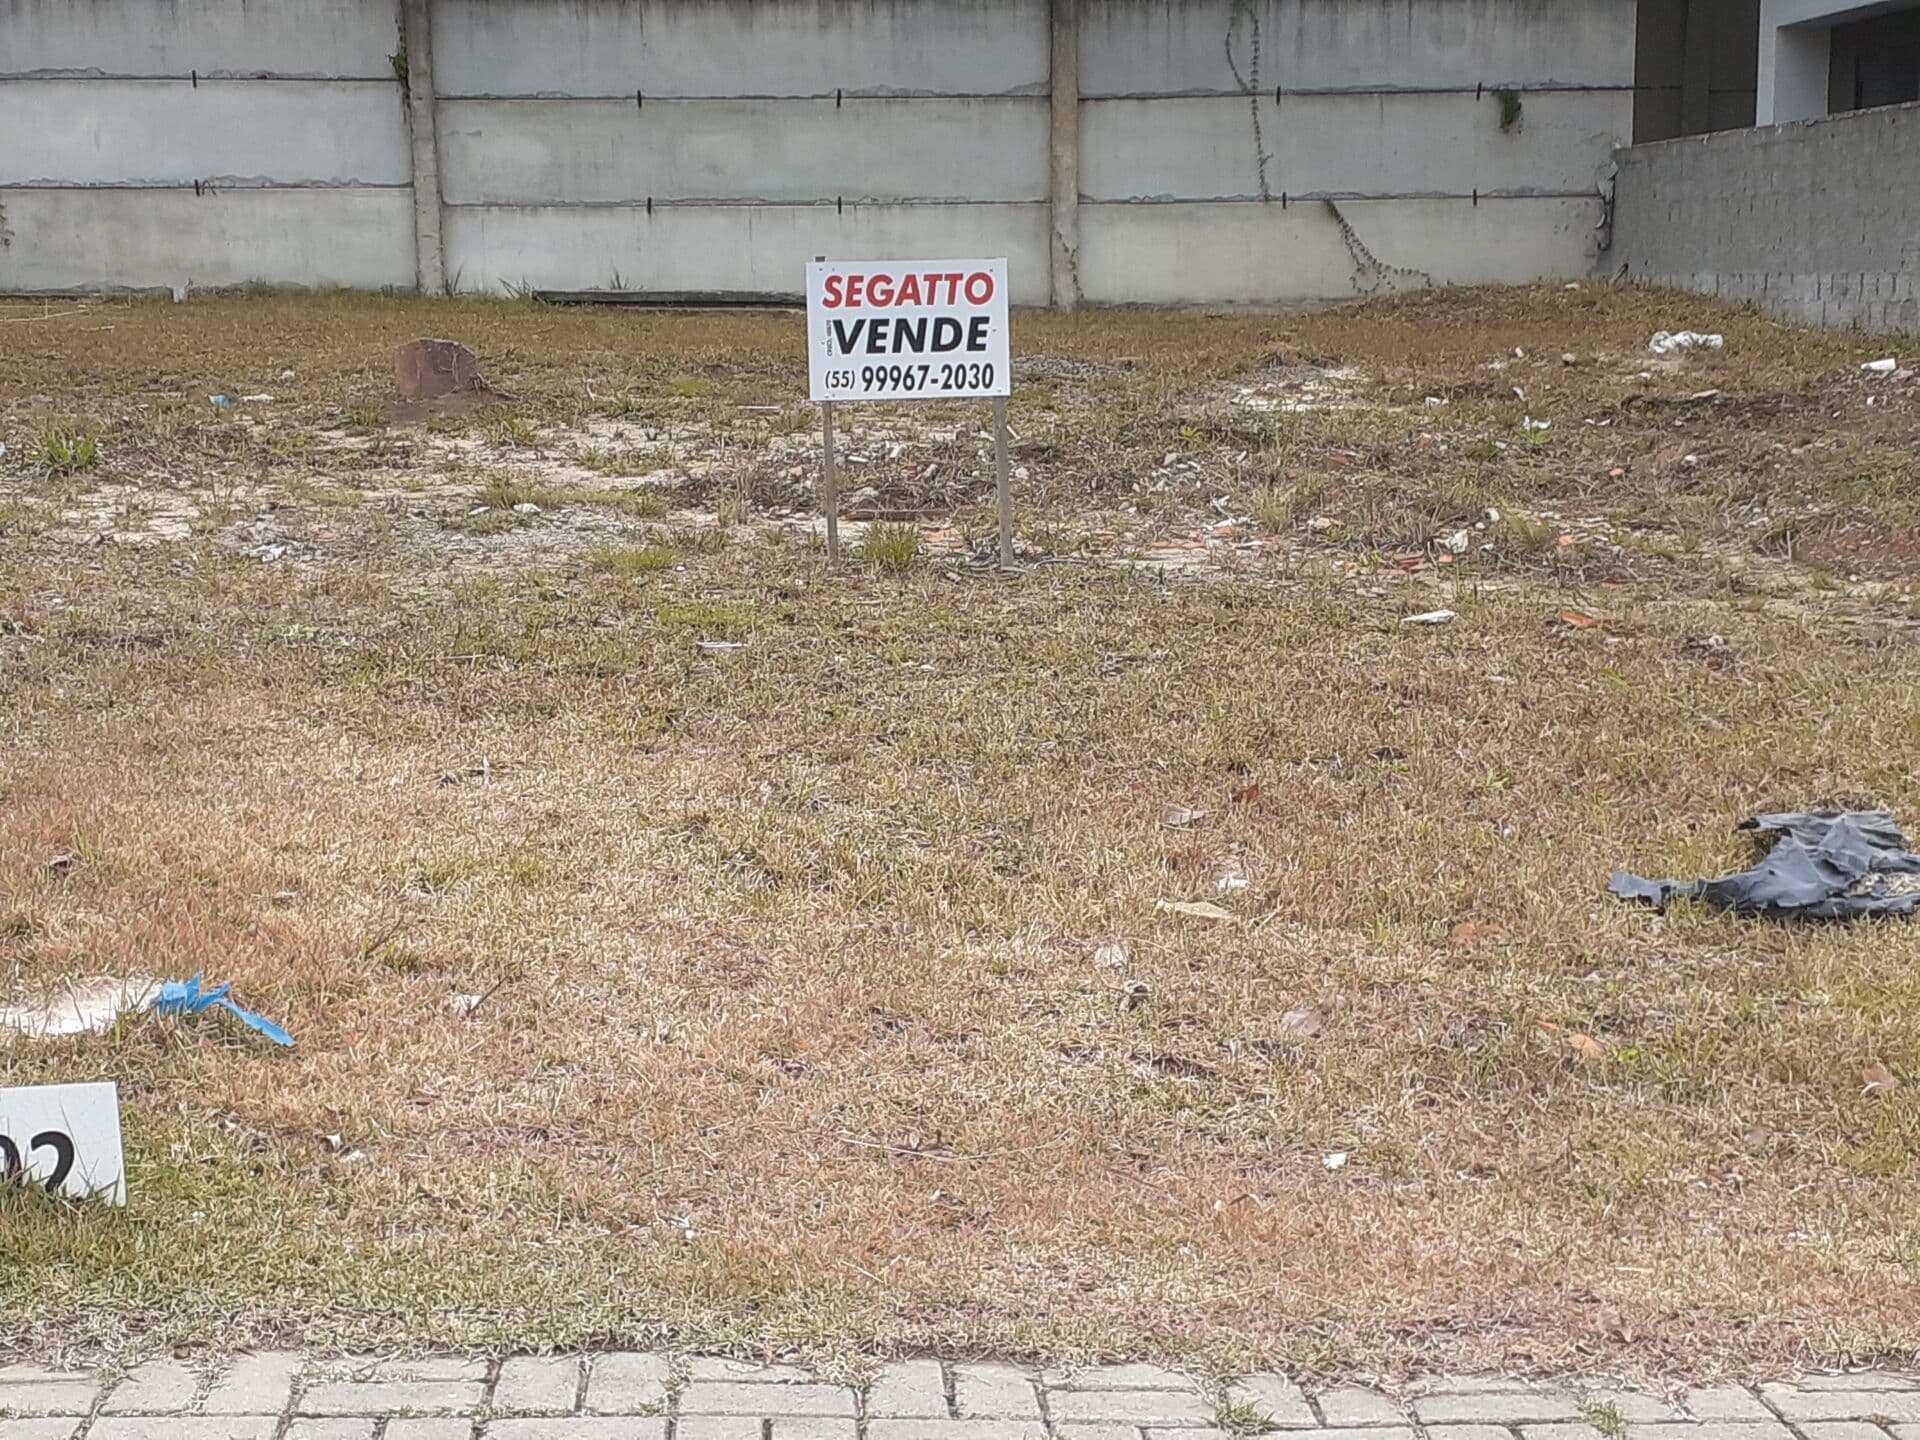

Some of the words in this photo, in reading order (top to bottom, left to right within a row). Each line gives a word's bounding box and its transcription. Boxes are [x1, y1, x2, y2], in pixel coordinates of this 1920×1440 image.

[822, 272, 994, 308] SEGATTO
[833, 316, 990, 355] VENDE
[825, 370, 856, 390] (55)
[861, 363, 994, 392] 99967-2030
